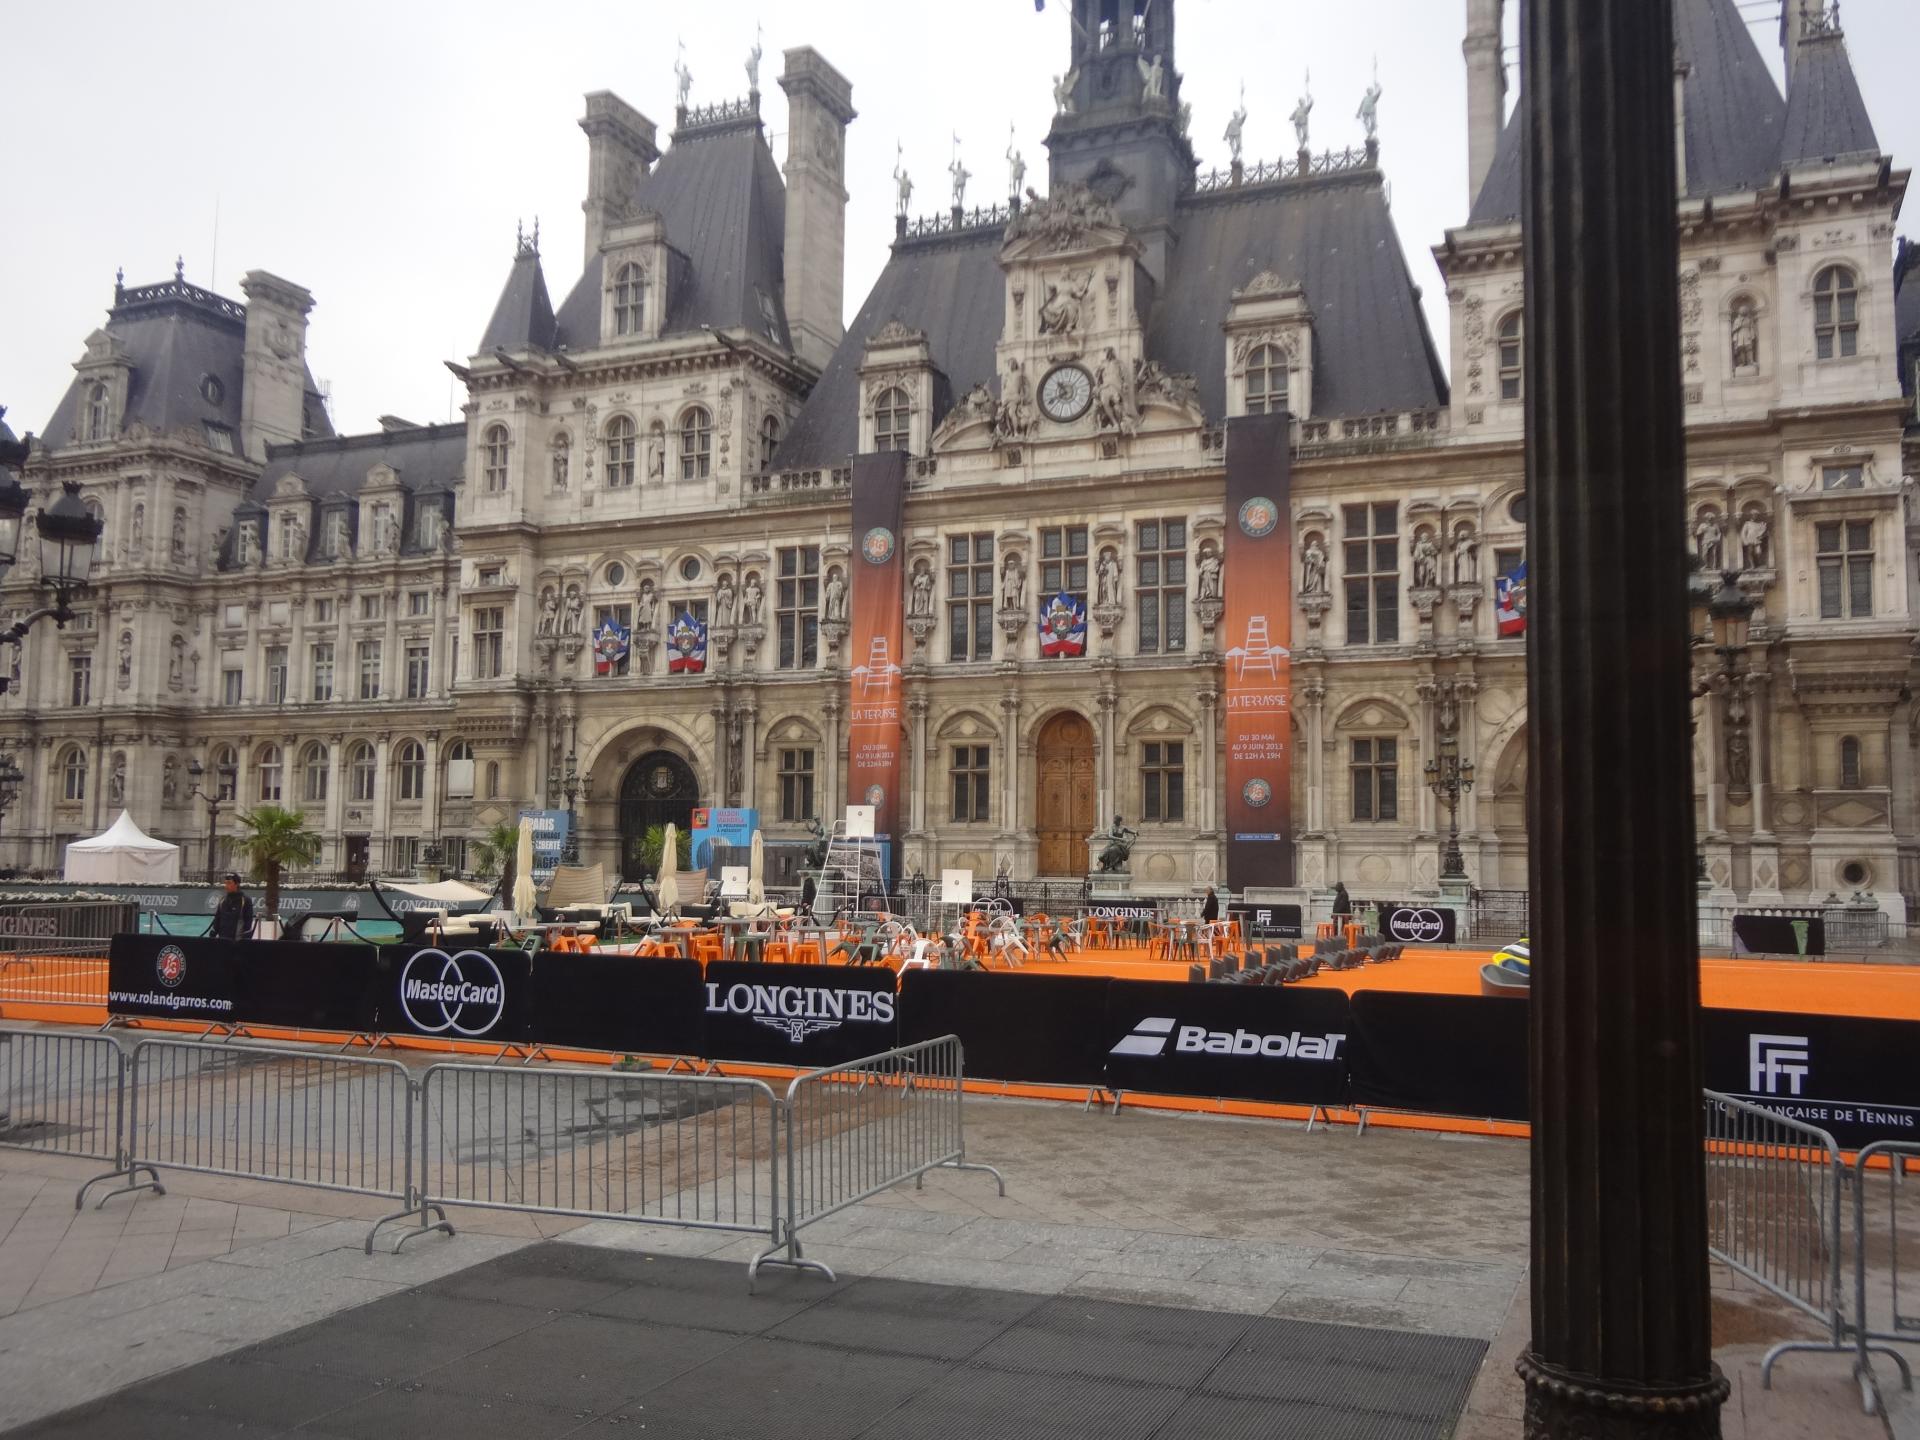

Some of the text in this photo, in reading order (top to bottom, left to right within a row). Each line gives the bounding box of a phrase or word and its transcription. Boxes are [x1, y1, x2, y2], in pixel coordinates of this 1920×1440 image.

[1227, 695, 1287, 707] LA TERRASSE
[120, 895, 179, 906] ONGINES
[0, 917, 58, 936] GINES
[1393, 920, 1440, 930] MasterCard
[109, 990, 233, 1010] www.rolandgarros.com
[406, 979, 499, 1004] MasterCard
[705, 982, 895, 1022] LONGINES
[1834, 1108, 1853, 1122] DE
[1857, 1108, 1914, 1127] TENNIS
